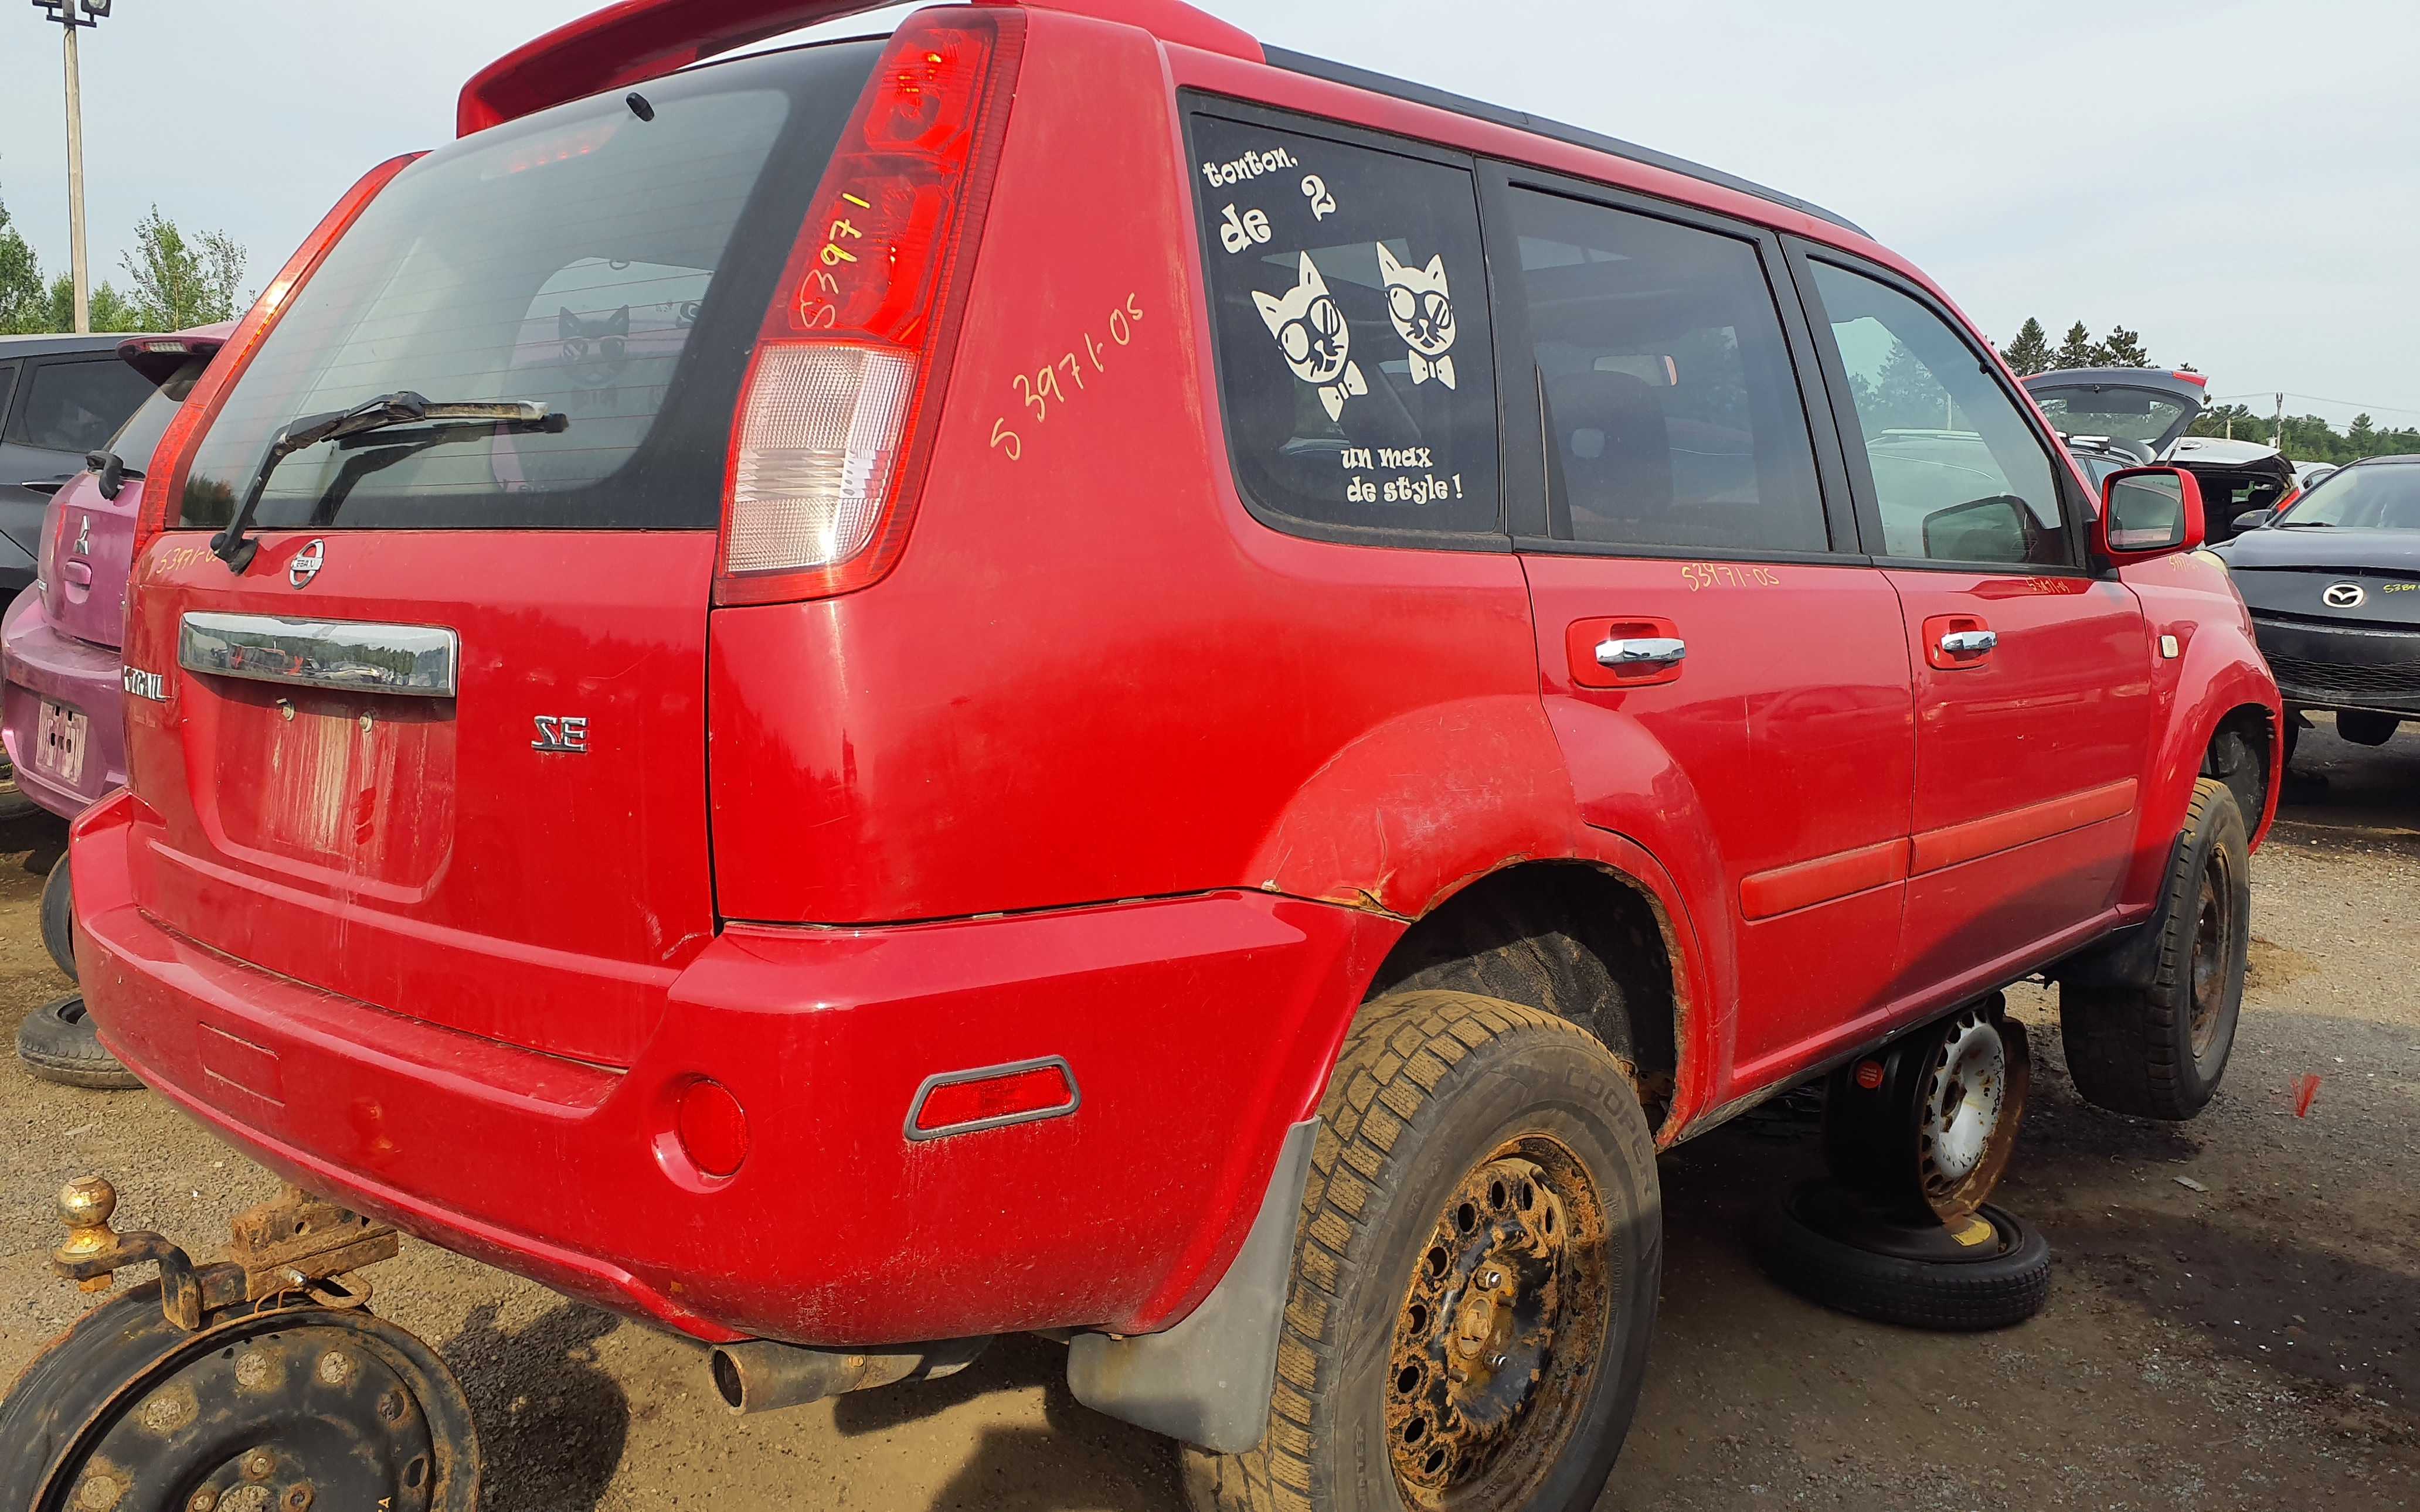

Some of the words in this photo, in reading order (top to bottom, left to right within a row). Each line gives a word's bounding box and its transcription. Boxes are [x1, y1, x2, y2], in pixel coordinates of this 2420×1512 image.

[1220, 203, 1272, 254] de
[1301, 174, 1337, 222] 2
[1341, 448, 1374, 470] un
[1378, 447, 1433, 469] max
[1347, 476, 1377, 503] de
[1384, 474, 1449, 505] style
[531, 715, 588, 752] SE
